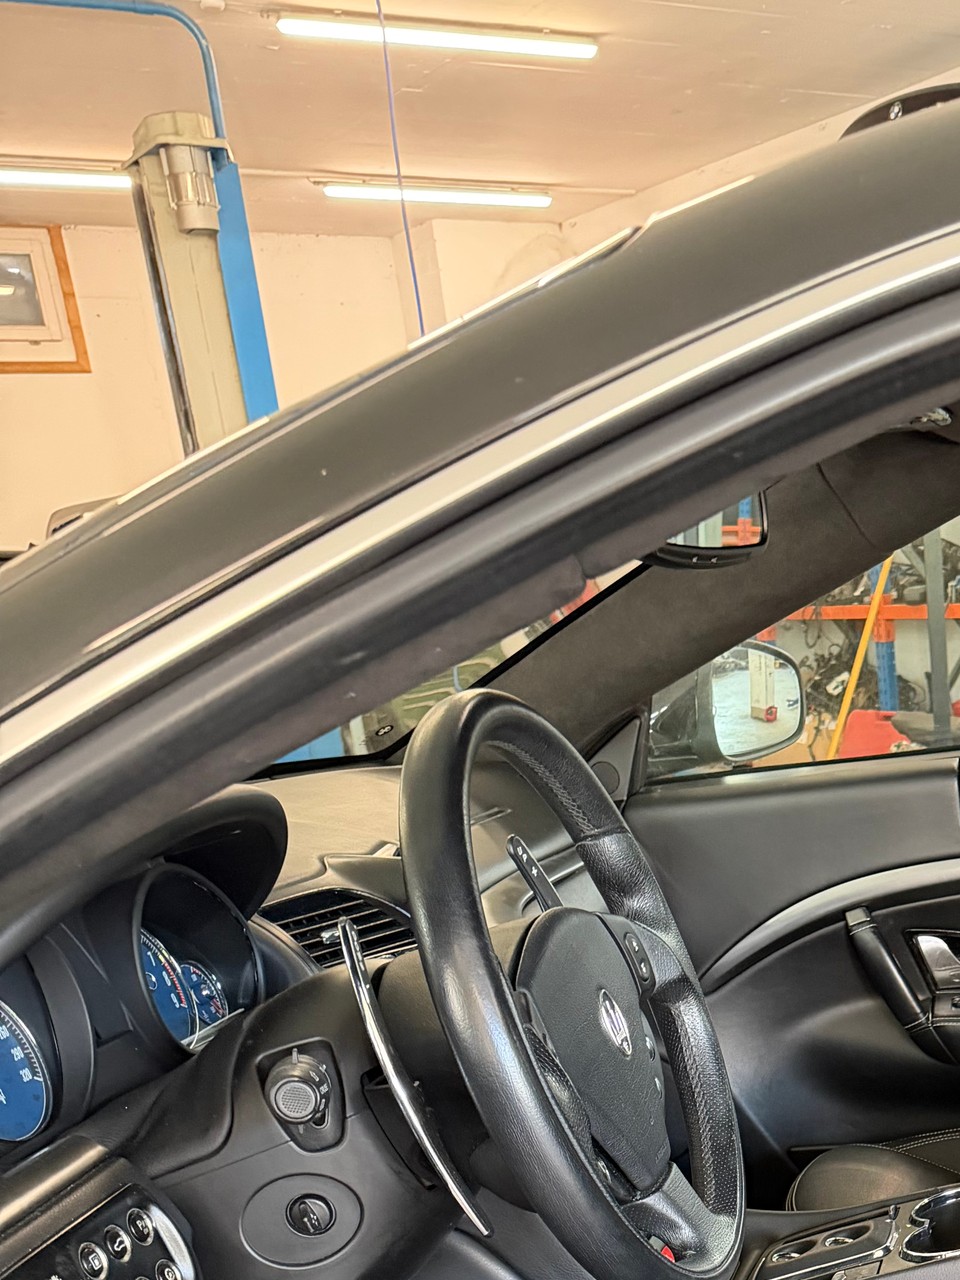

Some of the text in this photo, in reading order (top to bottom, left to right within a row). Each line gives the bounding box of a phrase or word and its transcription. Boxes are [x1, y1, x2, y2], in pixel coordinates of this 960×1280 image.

[162, 971, 171, 987] 8
[170, 993, 180, 1009] 9
[19, 1067, 33, 1083] 320
